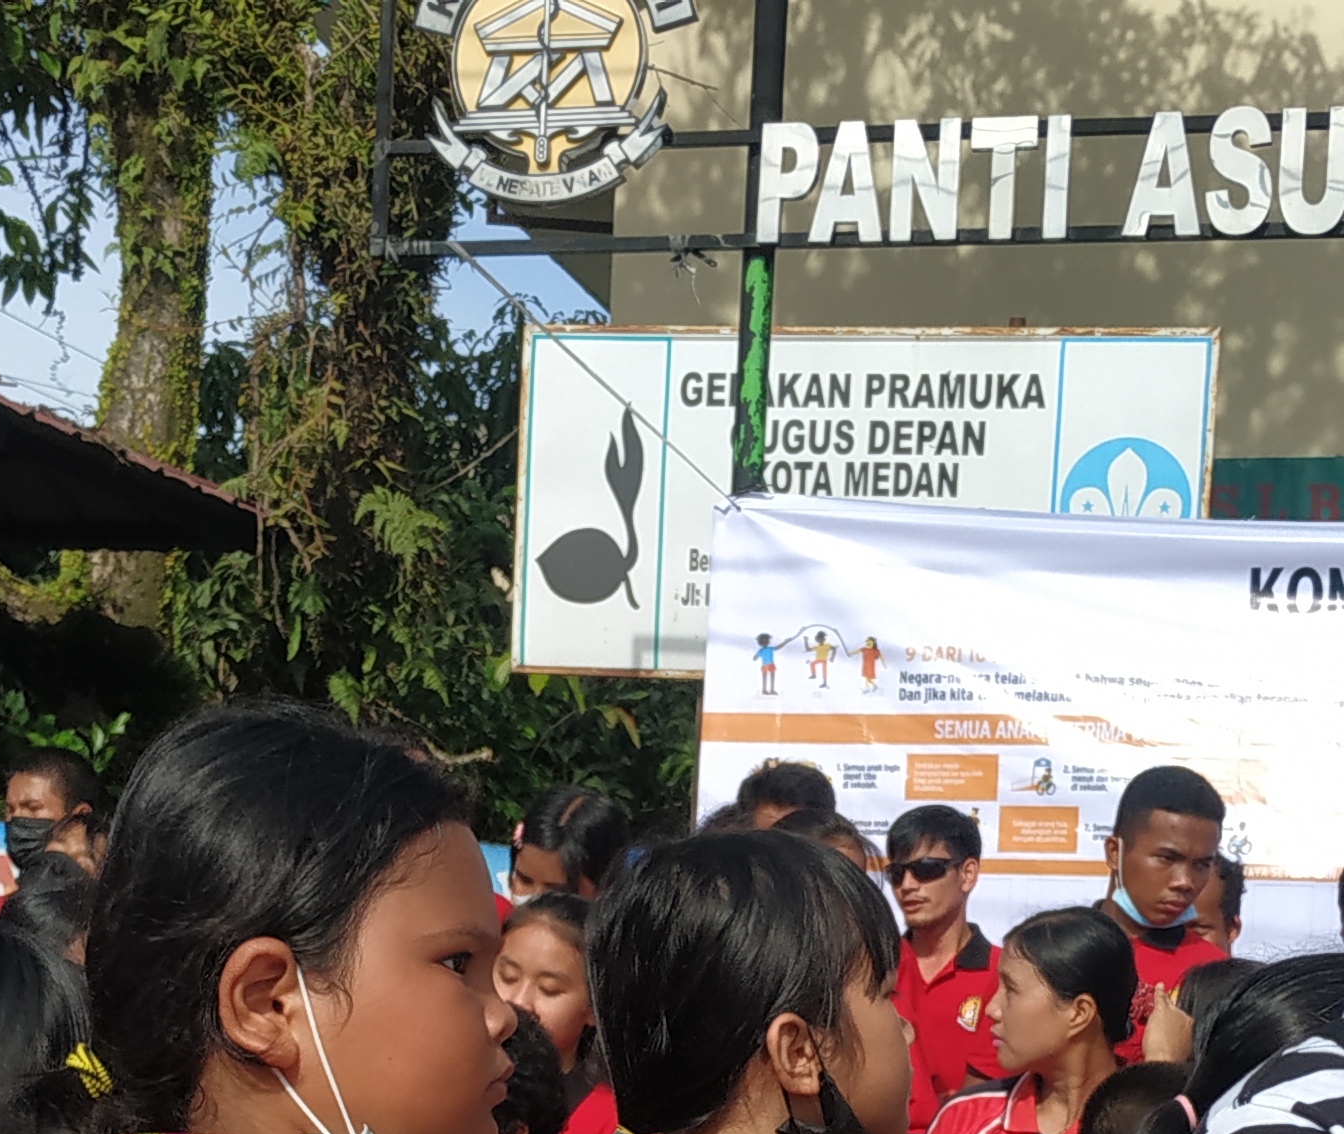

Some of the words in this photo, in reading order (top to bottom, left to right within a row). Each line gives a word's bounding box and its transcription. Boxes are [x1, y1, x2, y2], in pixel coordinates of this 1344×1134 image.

[757, 114, 1072, 243] PANTI
[680, 371, 852, 408] GEKAN
[864, 372, 1046, 409] PRAMUKA
[731, 419, 855, 455] UGUS
[867, 419, 986, 456] DEPAN
[844, 461, 959, 498] MEDAN
[899, 688, 922, 701] Dan
[925, 687, 946, 704] jika
[949, 688, 974, 701] kita
[934, 720, 991, 739] SEMUA
